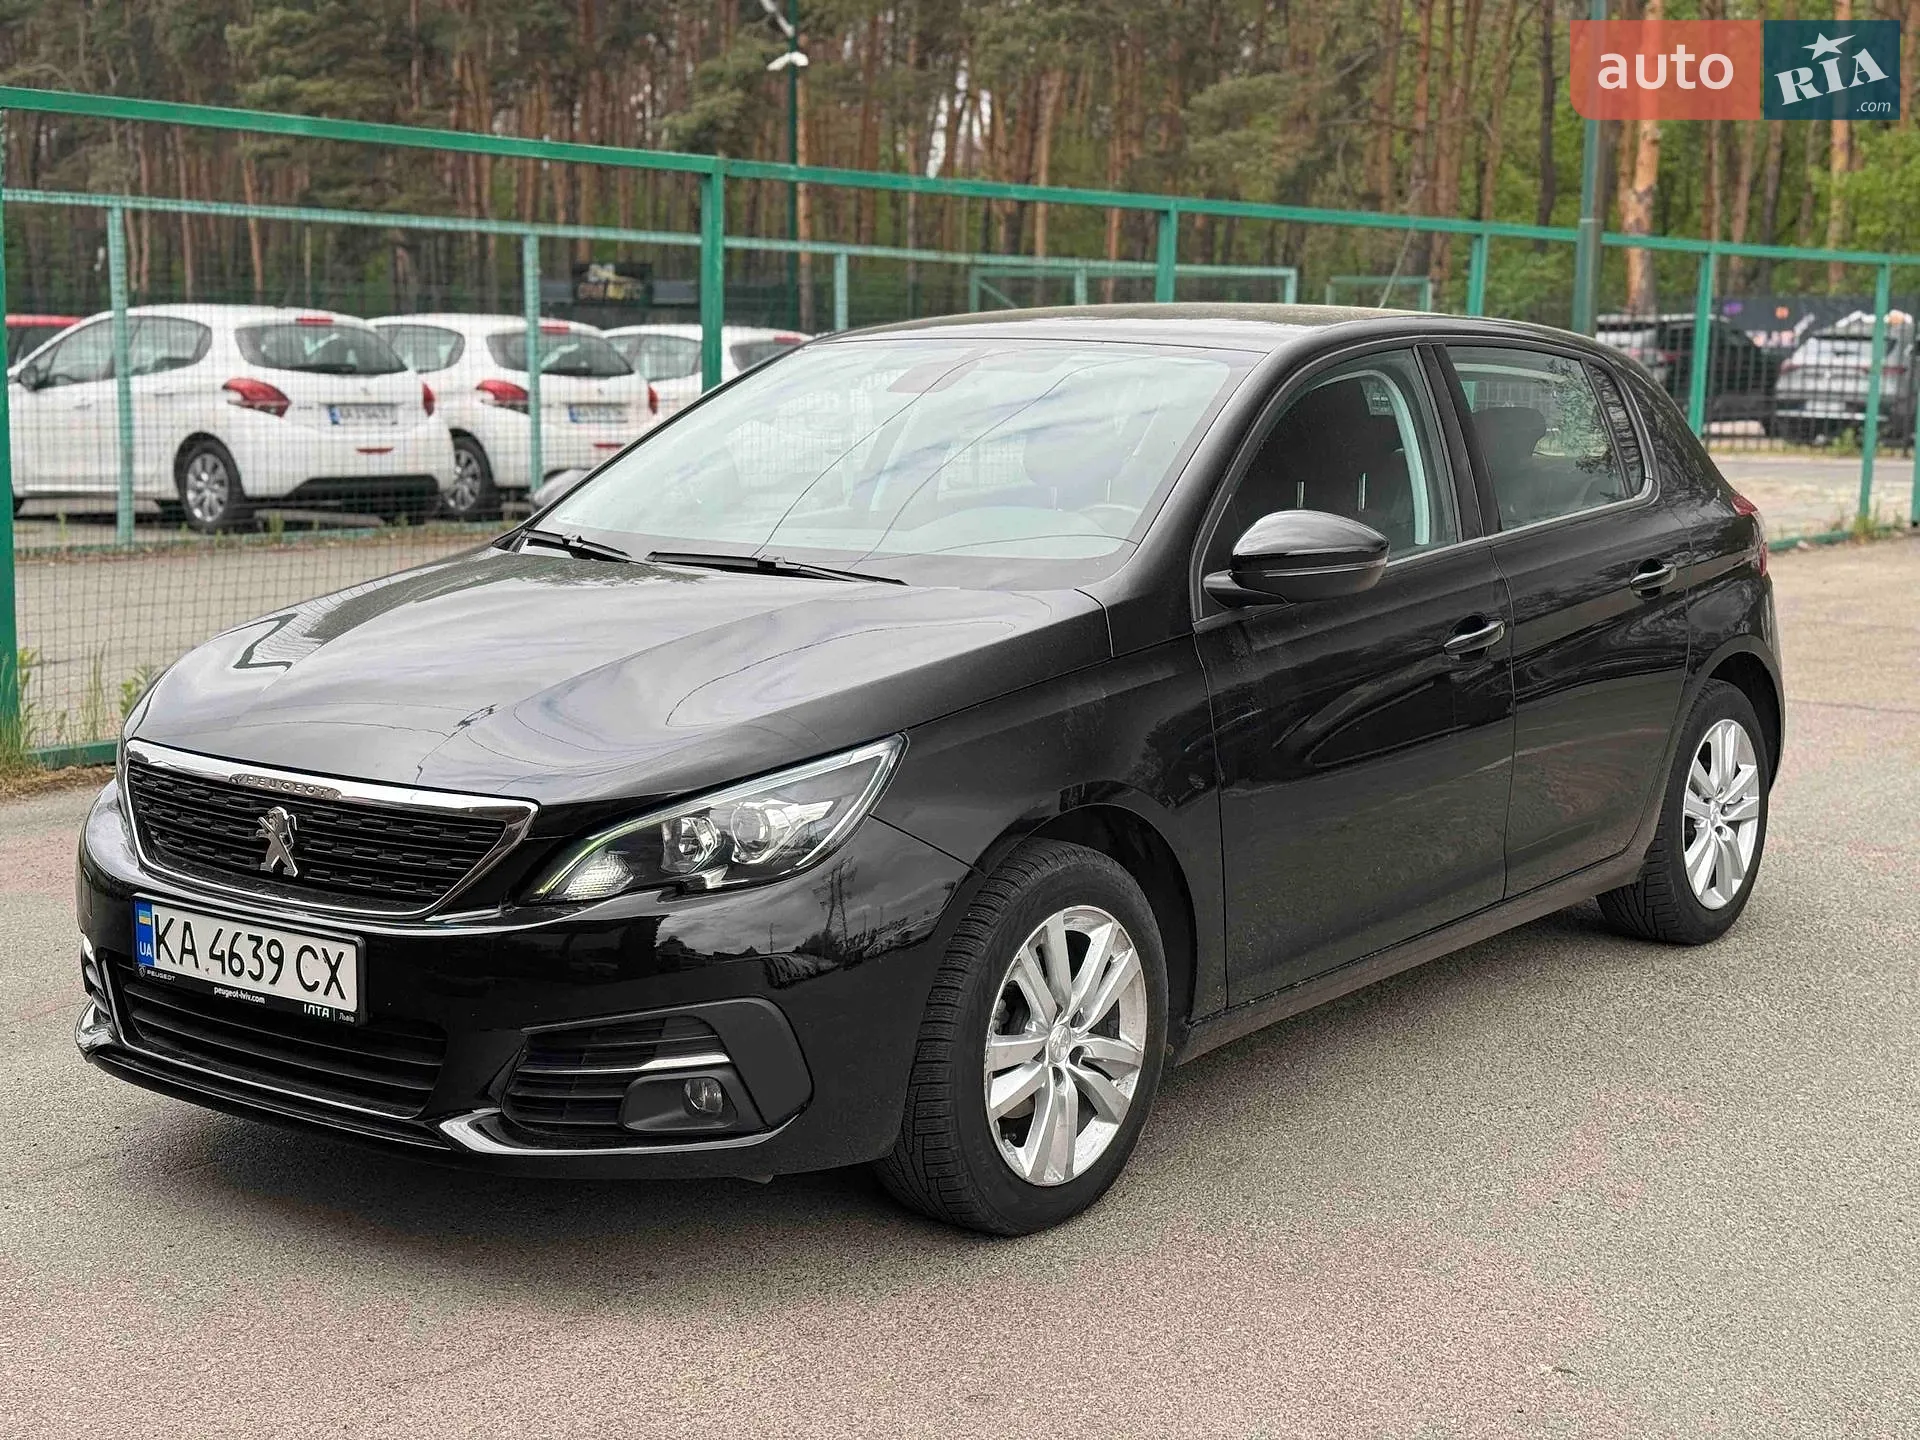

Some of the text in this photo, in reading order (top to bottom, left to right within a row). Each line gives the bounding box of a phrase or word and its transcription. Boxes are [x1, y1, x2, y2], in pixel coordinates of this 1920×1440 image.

[246, 776, 328, 797] PEUGEOT
[139, 941, 153, 958] UA
[154, 914, 347, 1000] KA 4639 CX
[146, 969, 176, 982] PEUGEOT
[213, 986, 266, 1004] peugeot-lviv.com
